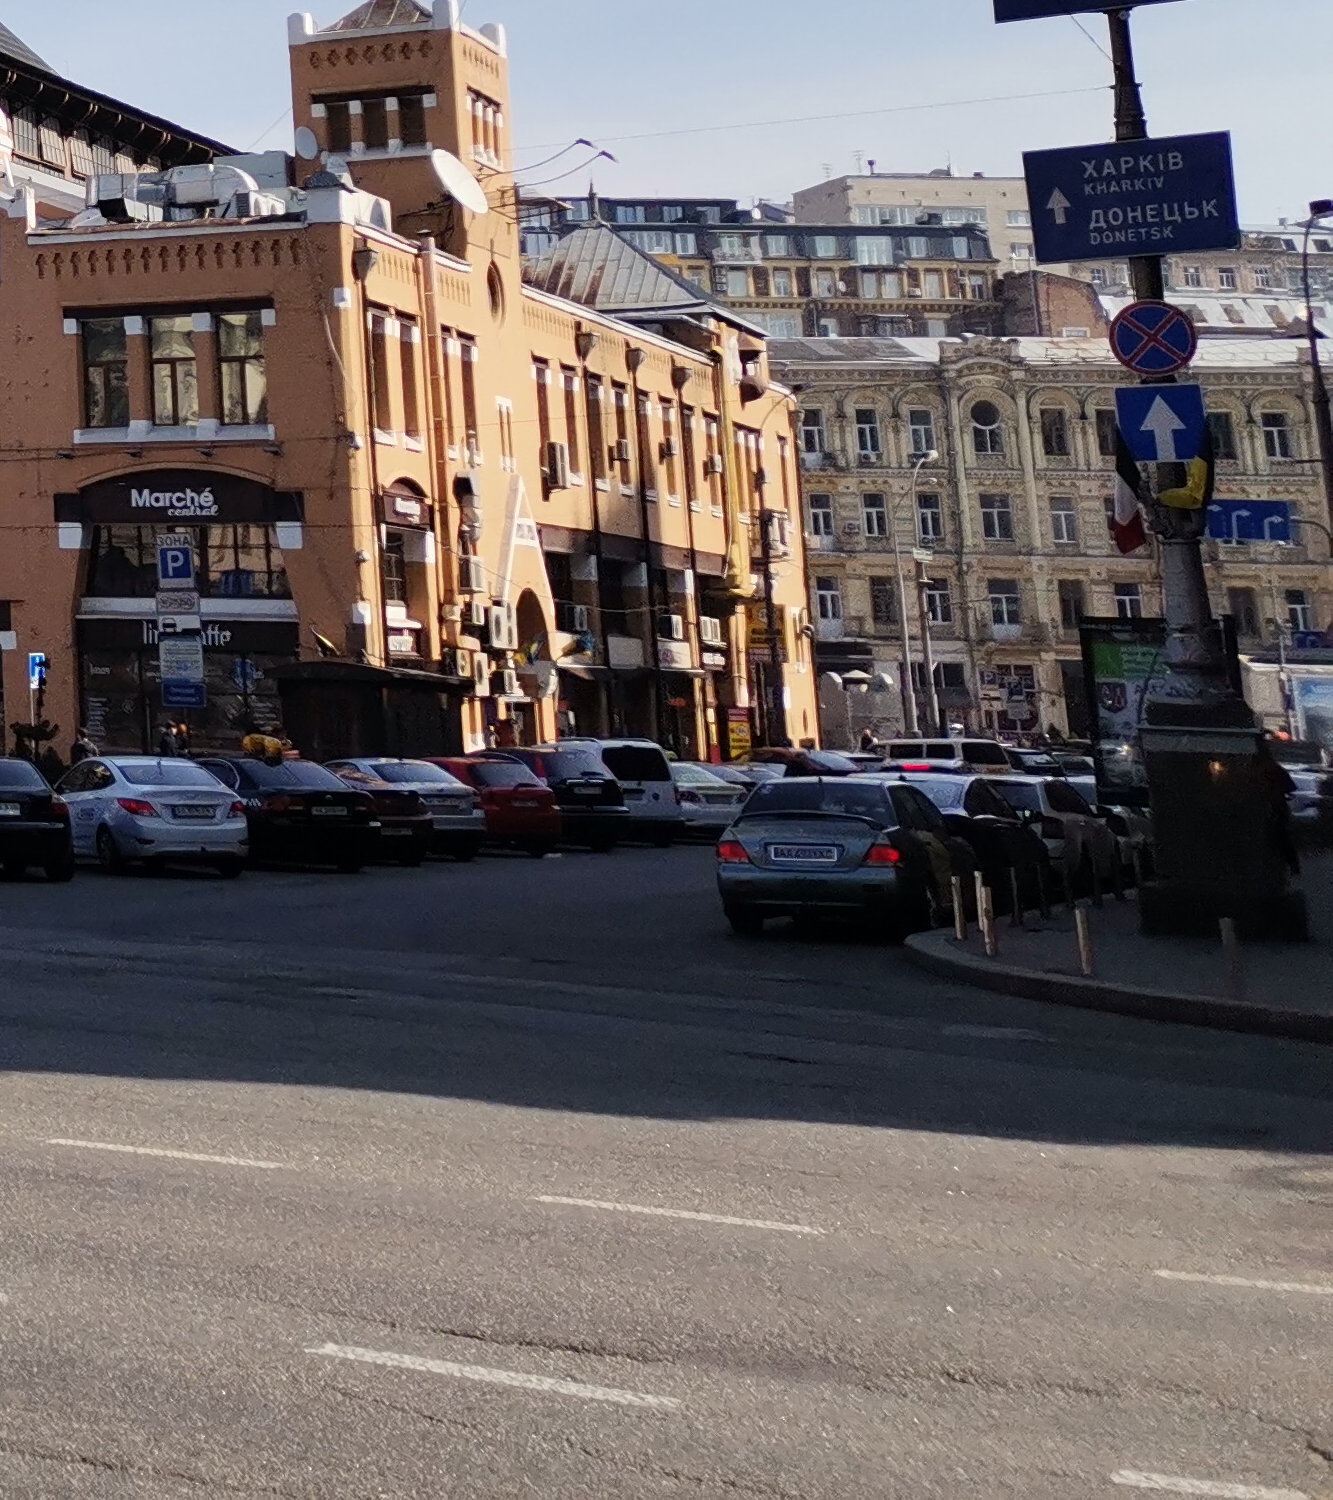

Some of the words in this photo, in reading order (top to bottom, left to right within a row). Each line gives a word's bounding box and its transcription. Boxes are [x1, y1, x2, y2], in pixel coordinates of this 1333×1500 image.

[1081, 152, 1183, 178] ХАРКІВ
[1084, 176, 1164, 196] KHARKIV
[1089, 199, 1219, 229] ДОНЕЦЬК
[1089, 225, 1174, 245] DONETSK
[131, 487, 215, 509] Marché
[168, 501, 220, 516] central
[157, 536, 191, 547] ЗОНА
